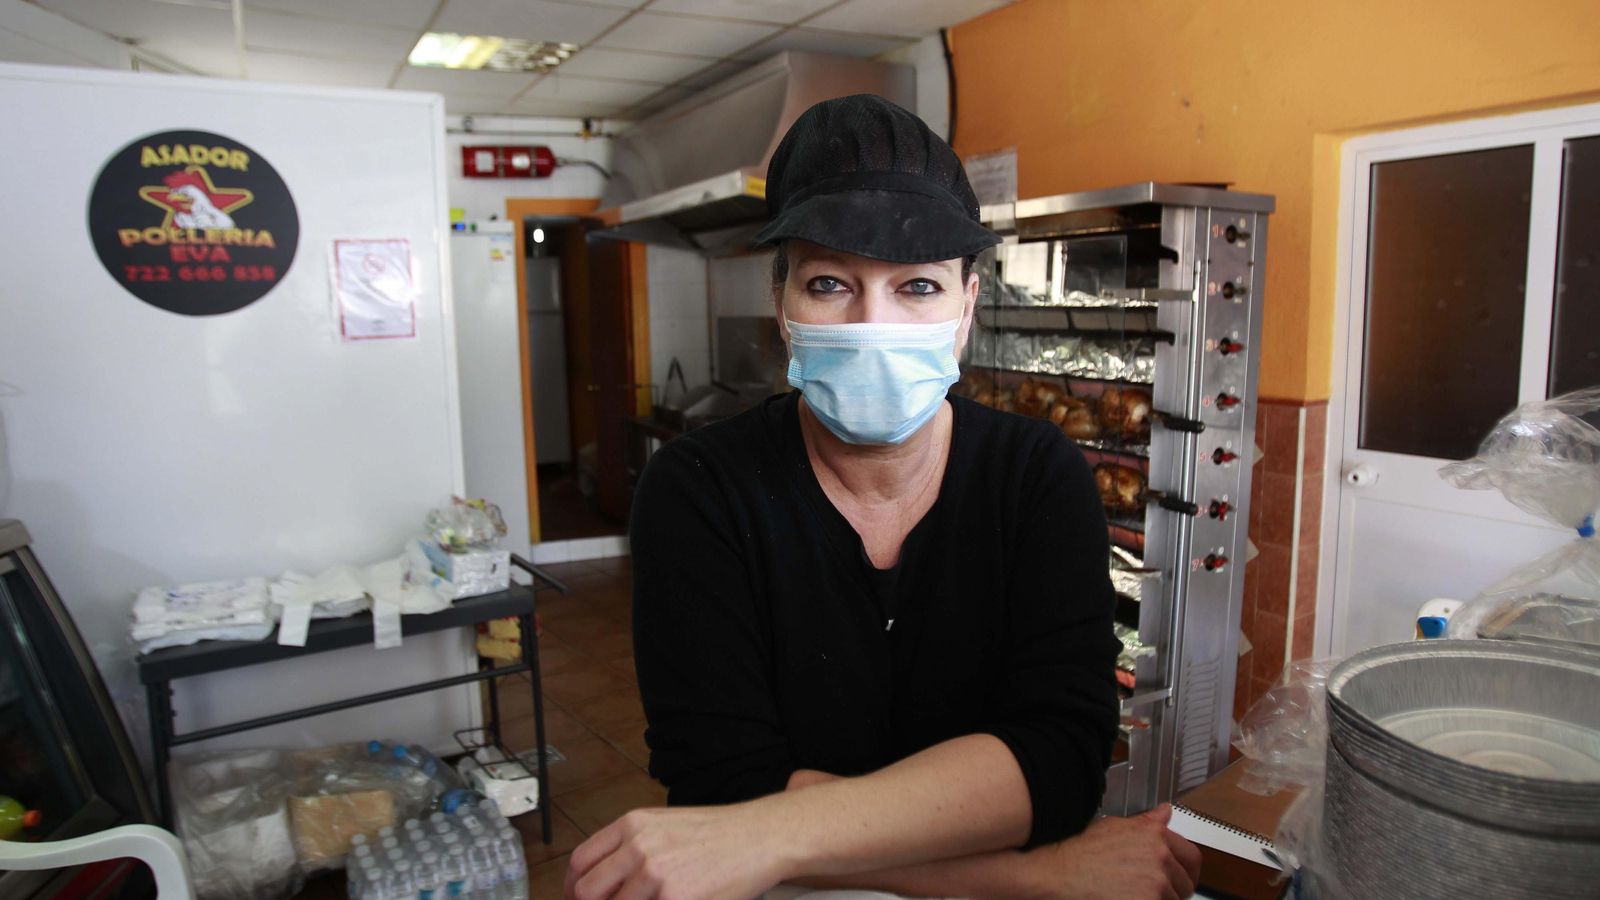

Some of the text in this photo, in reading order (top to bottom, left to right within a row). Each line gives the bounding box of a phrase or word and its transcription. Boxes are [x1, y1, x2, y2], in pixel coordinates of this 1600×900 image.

[141, 144, 249, 171] ASADOR
[170, 246, 231, 262] EVA
[125, 265, 170, 281] 722
